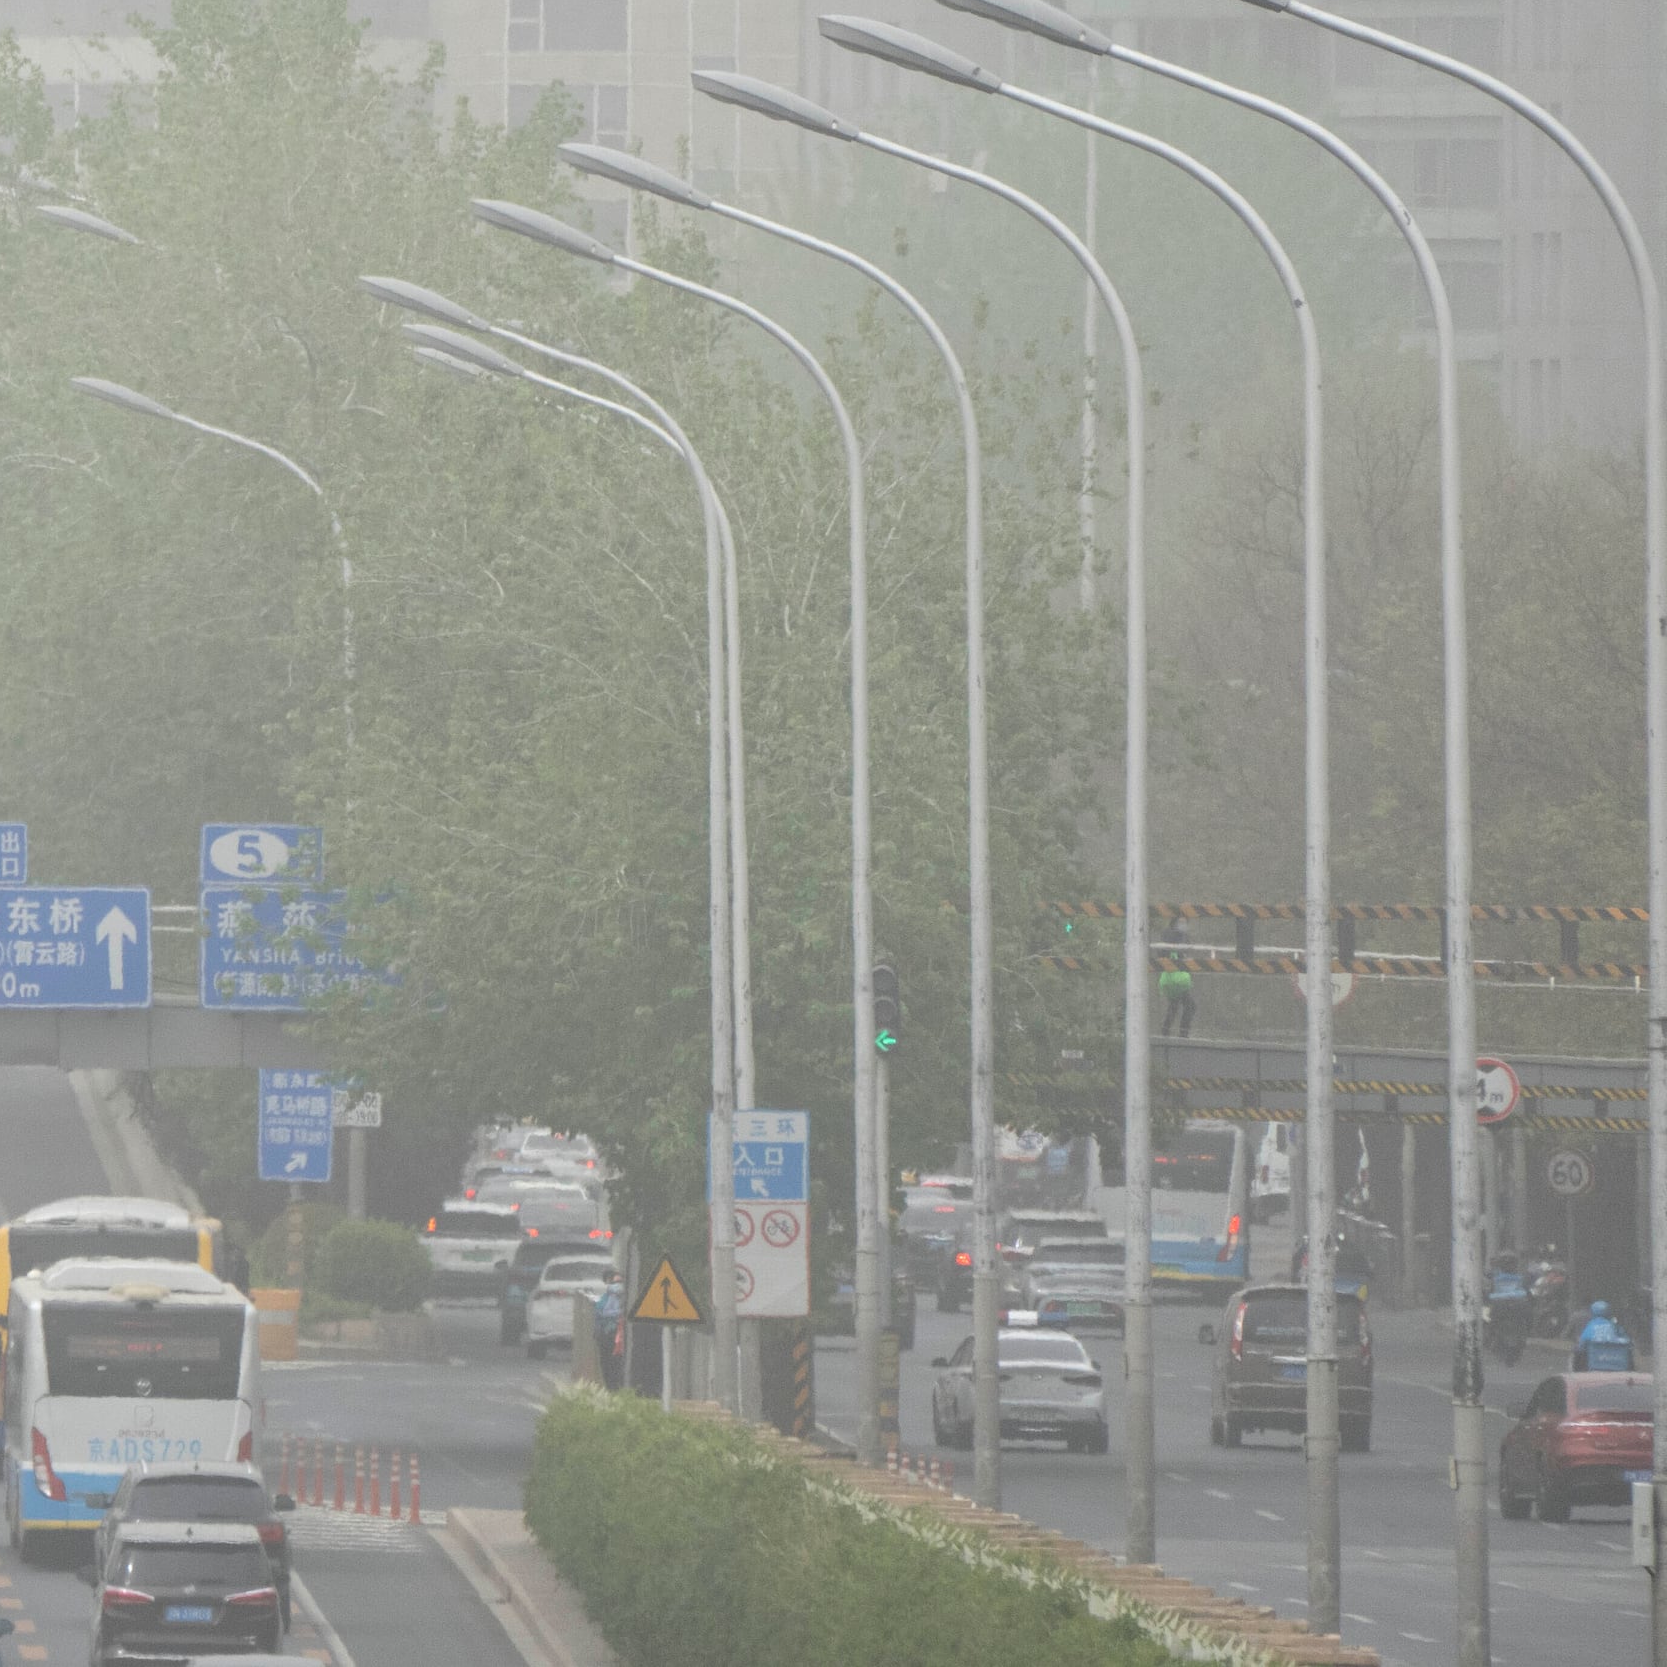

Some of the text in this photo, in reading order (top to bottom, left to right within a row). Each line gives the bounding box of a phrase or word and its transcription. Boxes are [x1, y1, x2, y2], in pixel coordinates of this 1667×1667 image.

[1, 832, 20, 876] 出口
[237, 834, 265, 873] 5
[734, 1145, 784, 1166] 入口
[1553, 1161, 1583, 1186] 60
